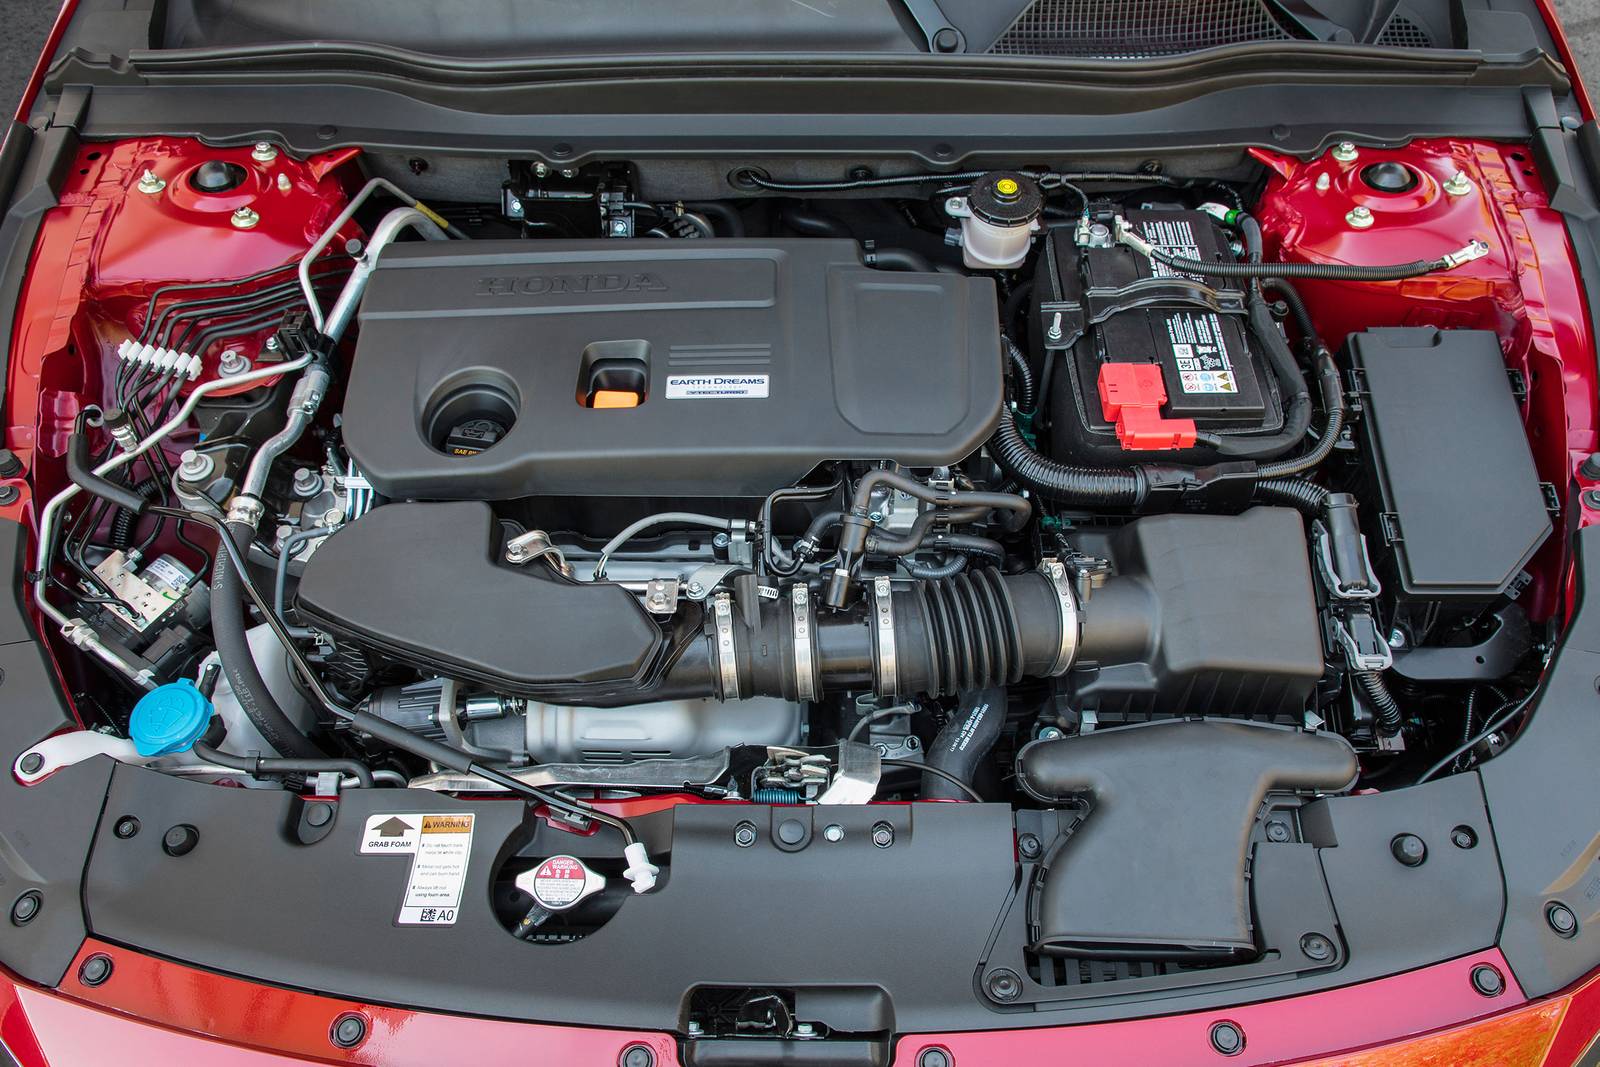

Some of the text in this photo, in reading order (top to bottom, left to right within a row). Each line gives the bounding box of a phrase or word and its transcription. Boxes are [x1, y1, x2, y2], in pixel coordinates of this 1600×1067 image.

[475, 272, 669, 296] HONDA
[714, 377, 765, 385] DREAMS
[437, 910, 454, 921] A0
